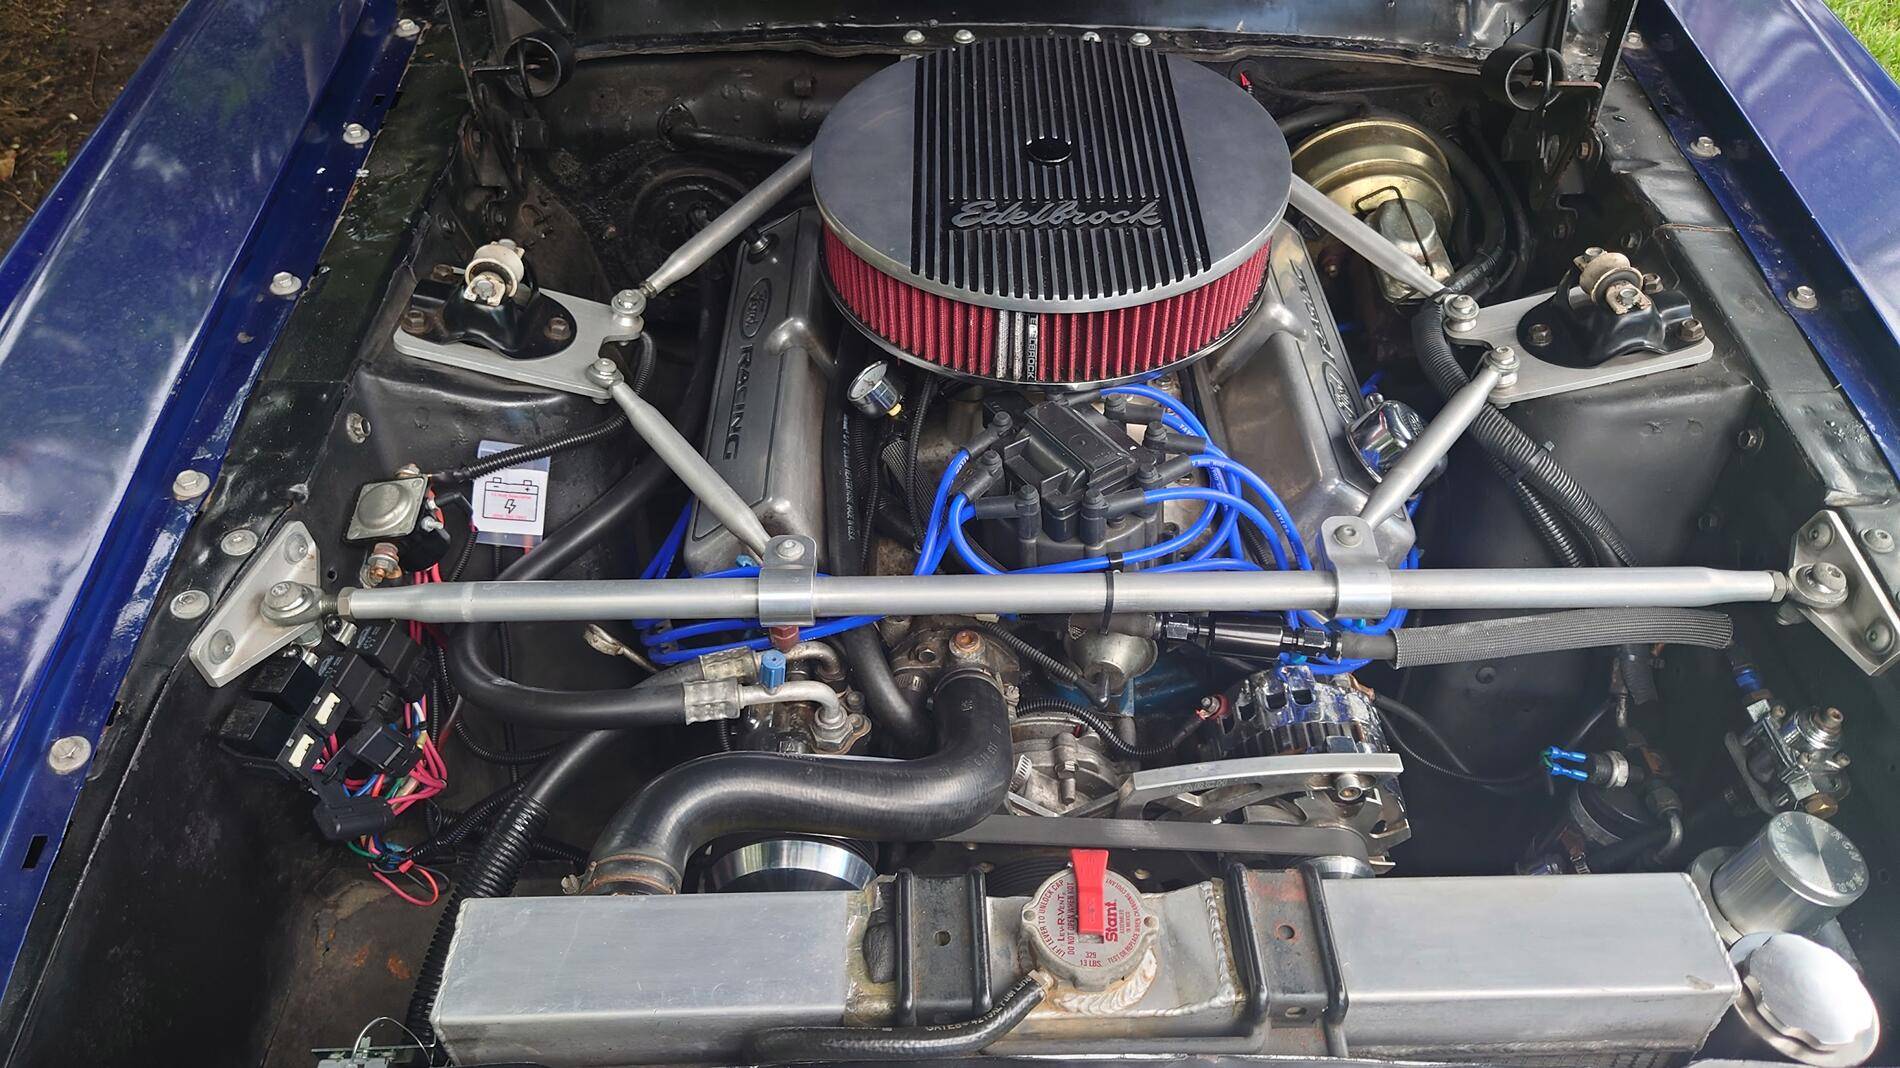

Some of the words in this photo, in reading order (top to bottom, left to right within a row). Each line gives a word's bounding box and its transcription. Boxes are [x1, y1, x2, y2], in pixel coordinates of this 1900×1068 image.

[951, 200, 1162, 227] Edelbrock
[723, 344, 753, 460] RACING
[1051, 879, 1064, 890] CAP
[1039, 889, 1054, 914] UNLOCK
[1038, 915, 1045, 924] TO
[1067, 914, 1075, 931] OPEN
[1105, 901, 1118, 942] Stant
[1040, 925, 1054, 945] LEVER
[1067, 932, 1075, 945] NOT
[1052, 945, 1066, 958] LIFT
[1068, 946, 1075, 956] DO
[1108, 954, 1121, 964] TEST
